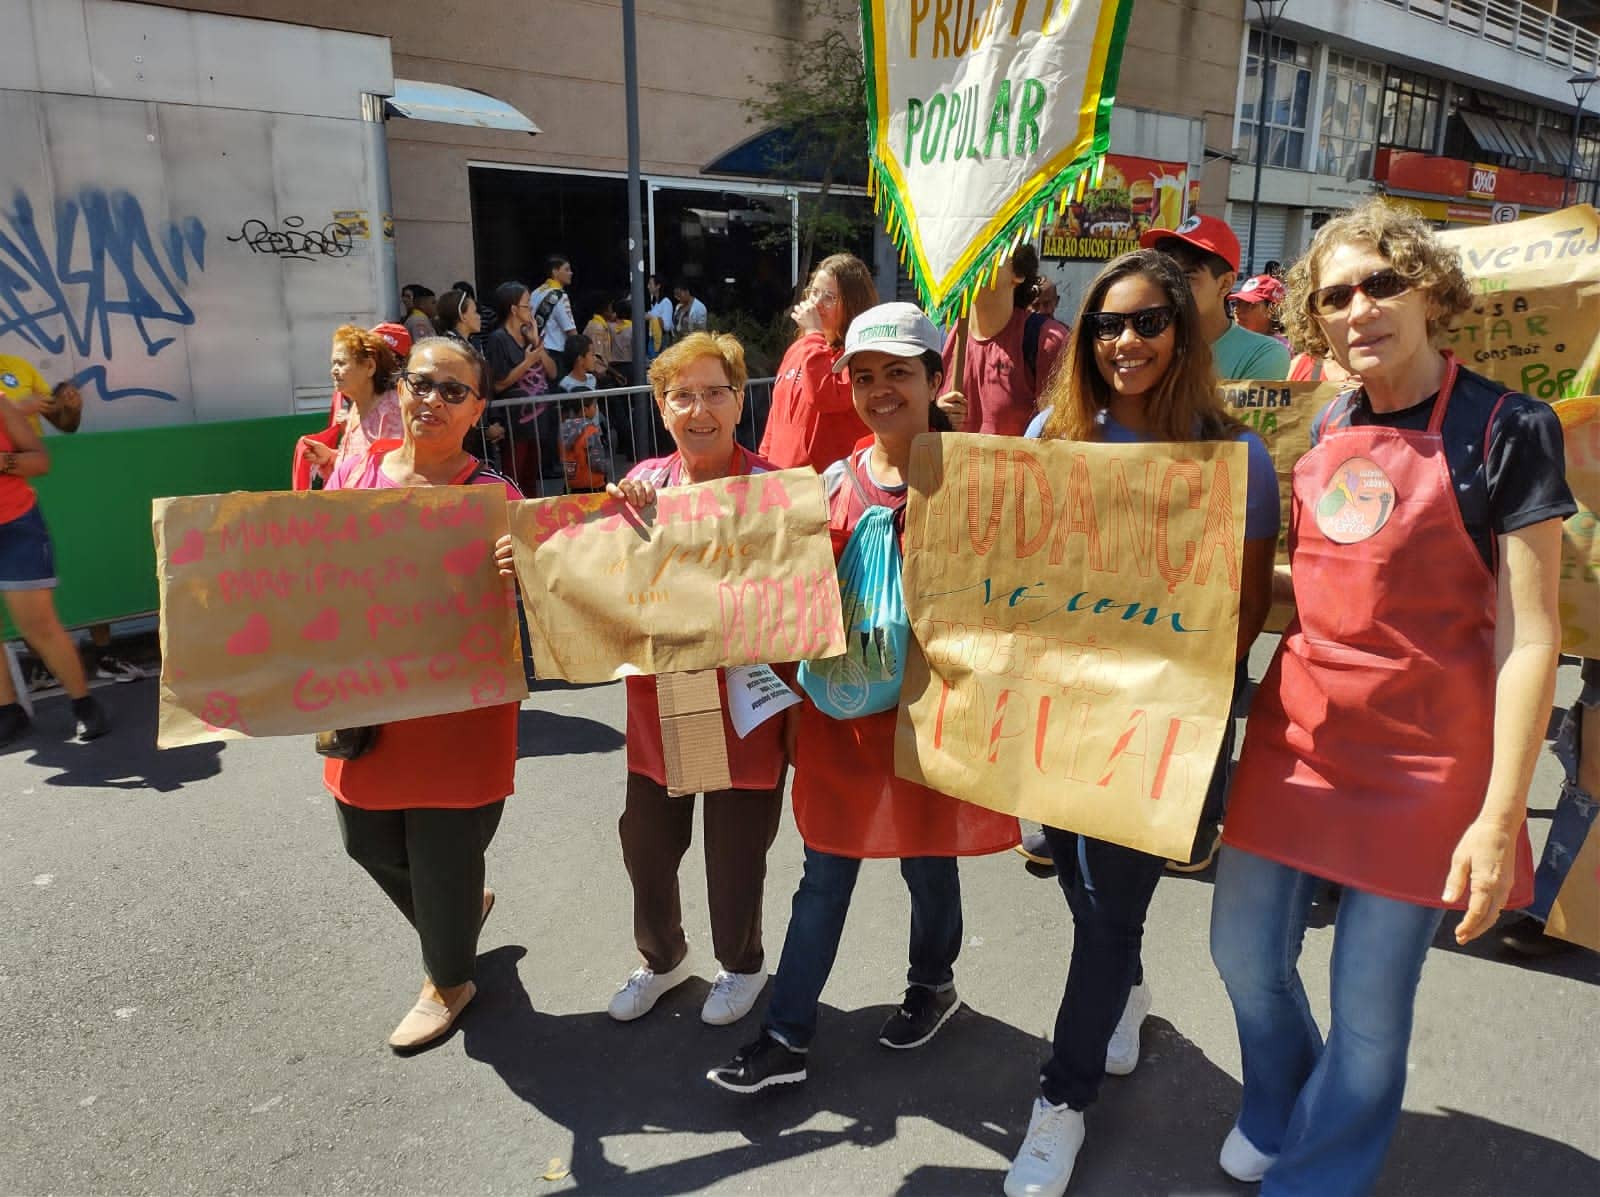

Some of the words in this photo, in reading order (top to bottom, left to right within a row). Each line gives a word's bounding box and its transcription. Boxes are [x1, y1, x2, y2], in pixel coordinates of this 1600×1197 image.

[903, 78, 1048, 167] POPULAR
[1472, 170, 1497, 193] OXXO
[1043, 233, 1078, 257] BARÃO
[1079, 237, 1109, 258] SUCOS
[1110, 239, 1116, 258] E
[656, 477, 791, 527] MATA
[912, 444, 1240, 594] MUDANÇA
[933, 679, 1202, 802] POPULAR
